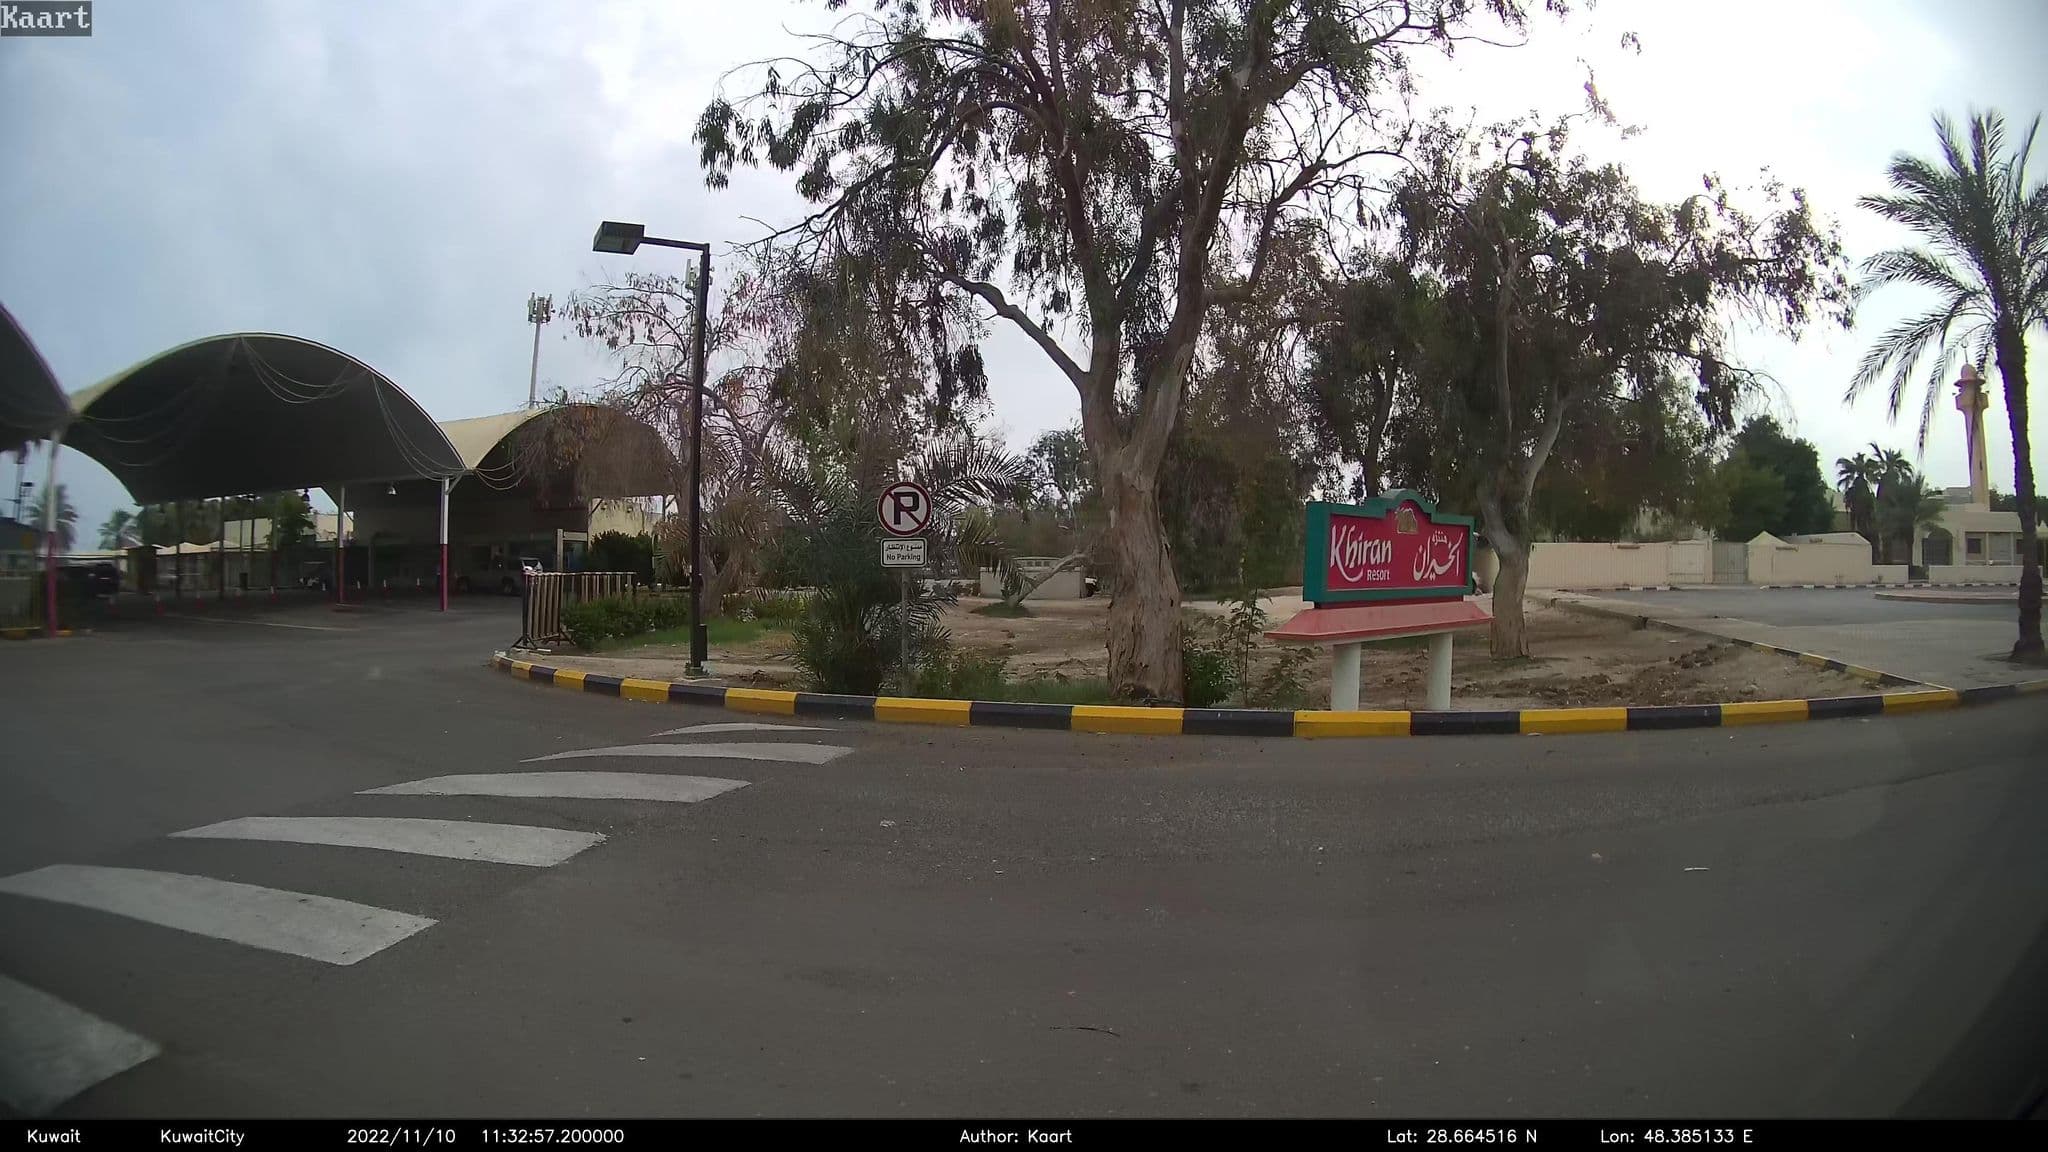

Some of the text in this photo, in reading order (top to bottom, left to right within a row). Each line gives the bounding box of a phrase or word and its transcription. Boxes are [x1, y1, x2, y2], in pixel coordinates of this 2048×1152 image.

[886, 553, 921, 562] No Parking
[1329, 524, 1392, 583] Khiran
[1413, 532, 1464, 582] الخيران
[1366, 569, 1390, 582] Resort
